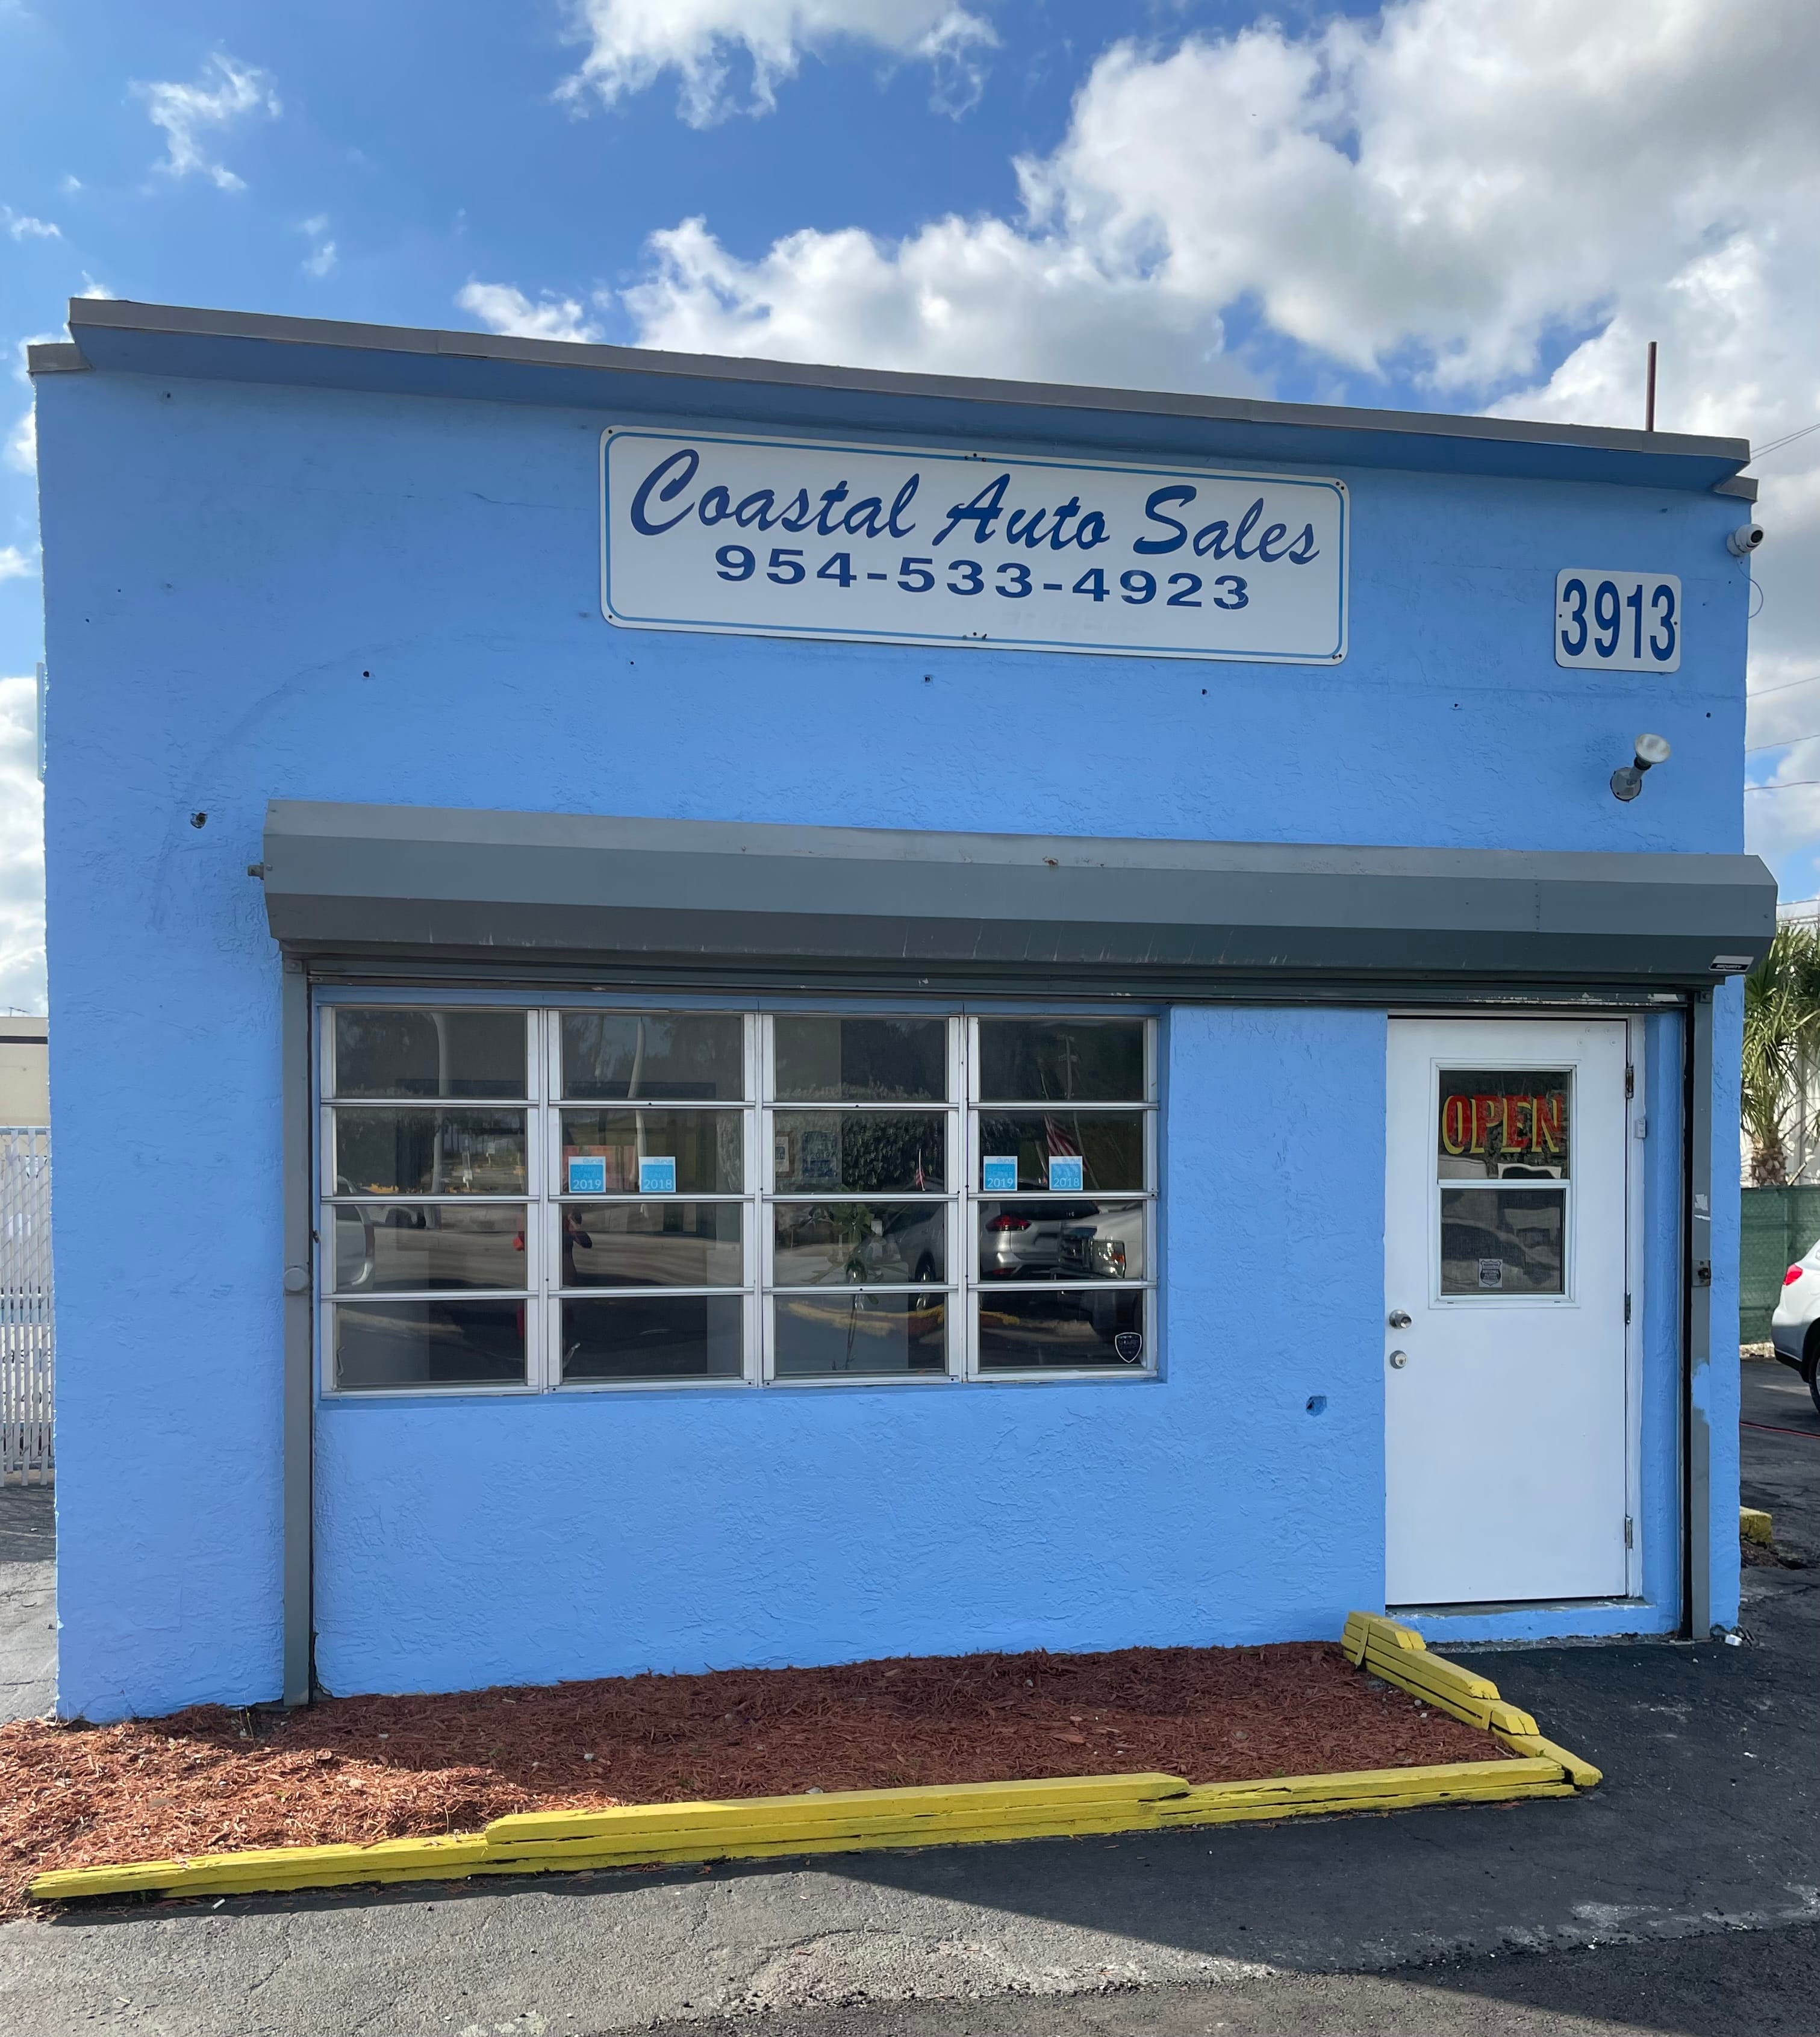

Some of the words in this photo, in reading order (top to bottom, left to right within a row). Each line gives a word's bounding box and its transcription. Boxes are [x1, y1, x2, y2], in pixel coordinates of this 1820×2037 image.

[631, 449, 920, 538] Coastal
[932, 473, 1110, 551] Auto
[1133, 485, 1320, 565] Sales
[715, 544, 1250, 610] 954-533-4923
[1561, 578, 1675, 661] 3913
[1442, 1094, 1563, 1155] OPEN
[573, 1179, 602, 1190] 2019
[644, 1179, 673, 1190] 2018
[987, 1178, 1014, 1187] 2019
[1054, 1178, 1080, 1187] 2018
